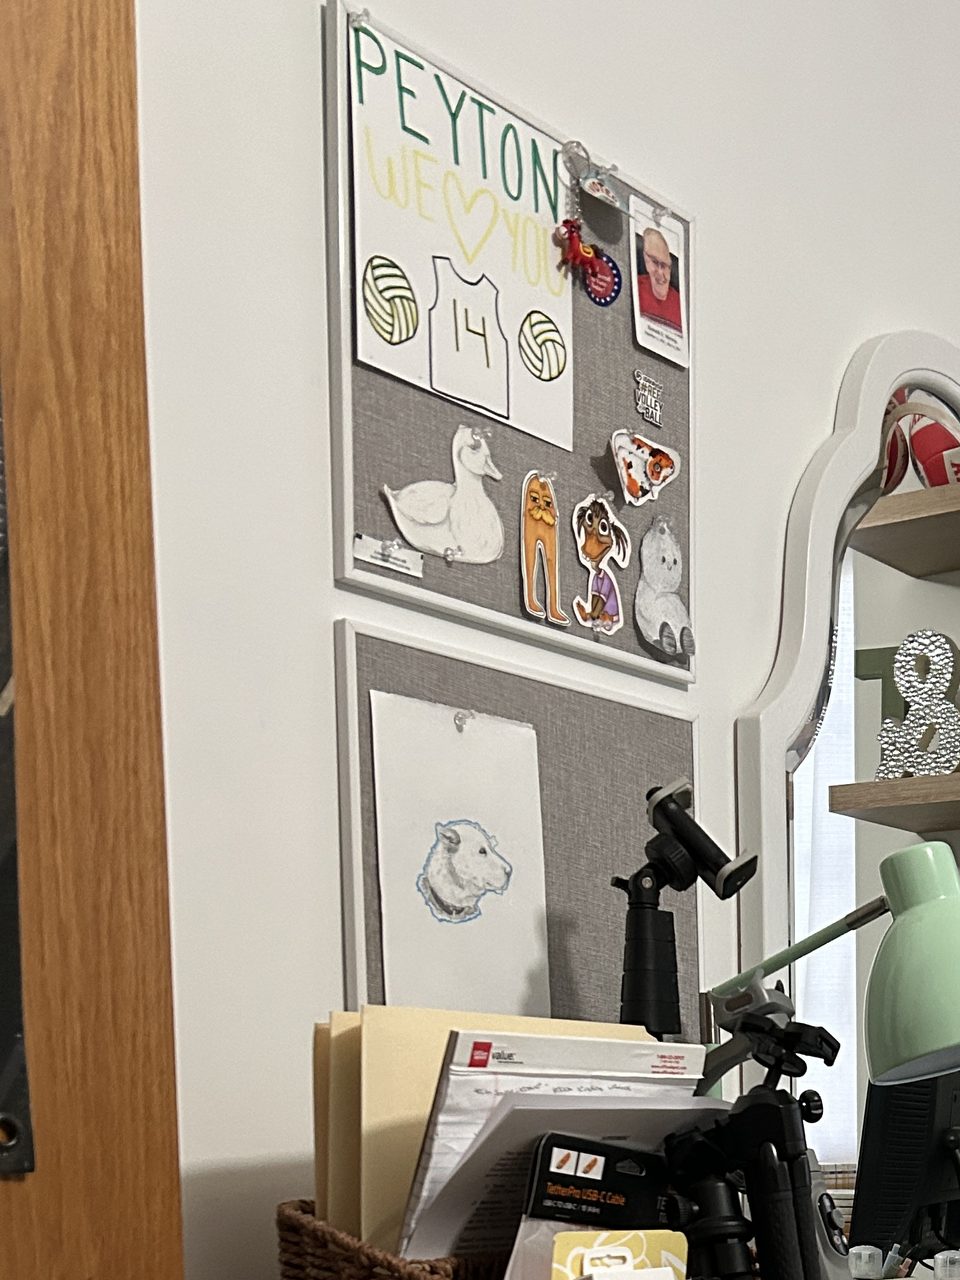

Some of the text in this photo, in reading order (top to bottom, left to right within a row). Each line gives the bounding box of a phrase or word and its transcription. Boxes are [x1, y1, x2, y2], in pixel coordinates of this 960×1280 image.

[353, 25, 560, 223] PEYTON
[364, 125, 565, 297] WE YOU
[453, 298, 489, 369] 14
[606, 1192, 625, 1206] Cable
